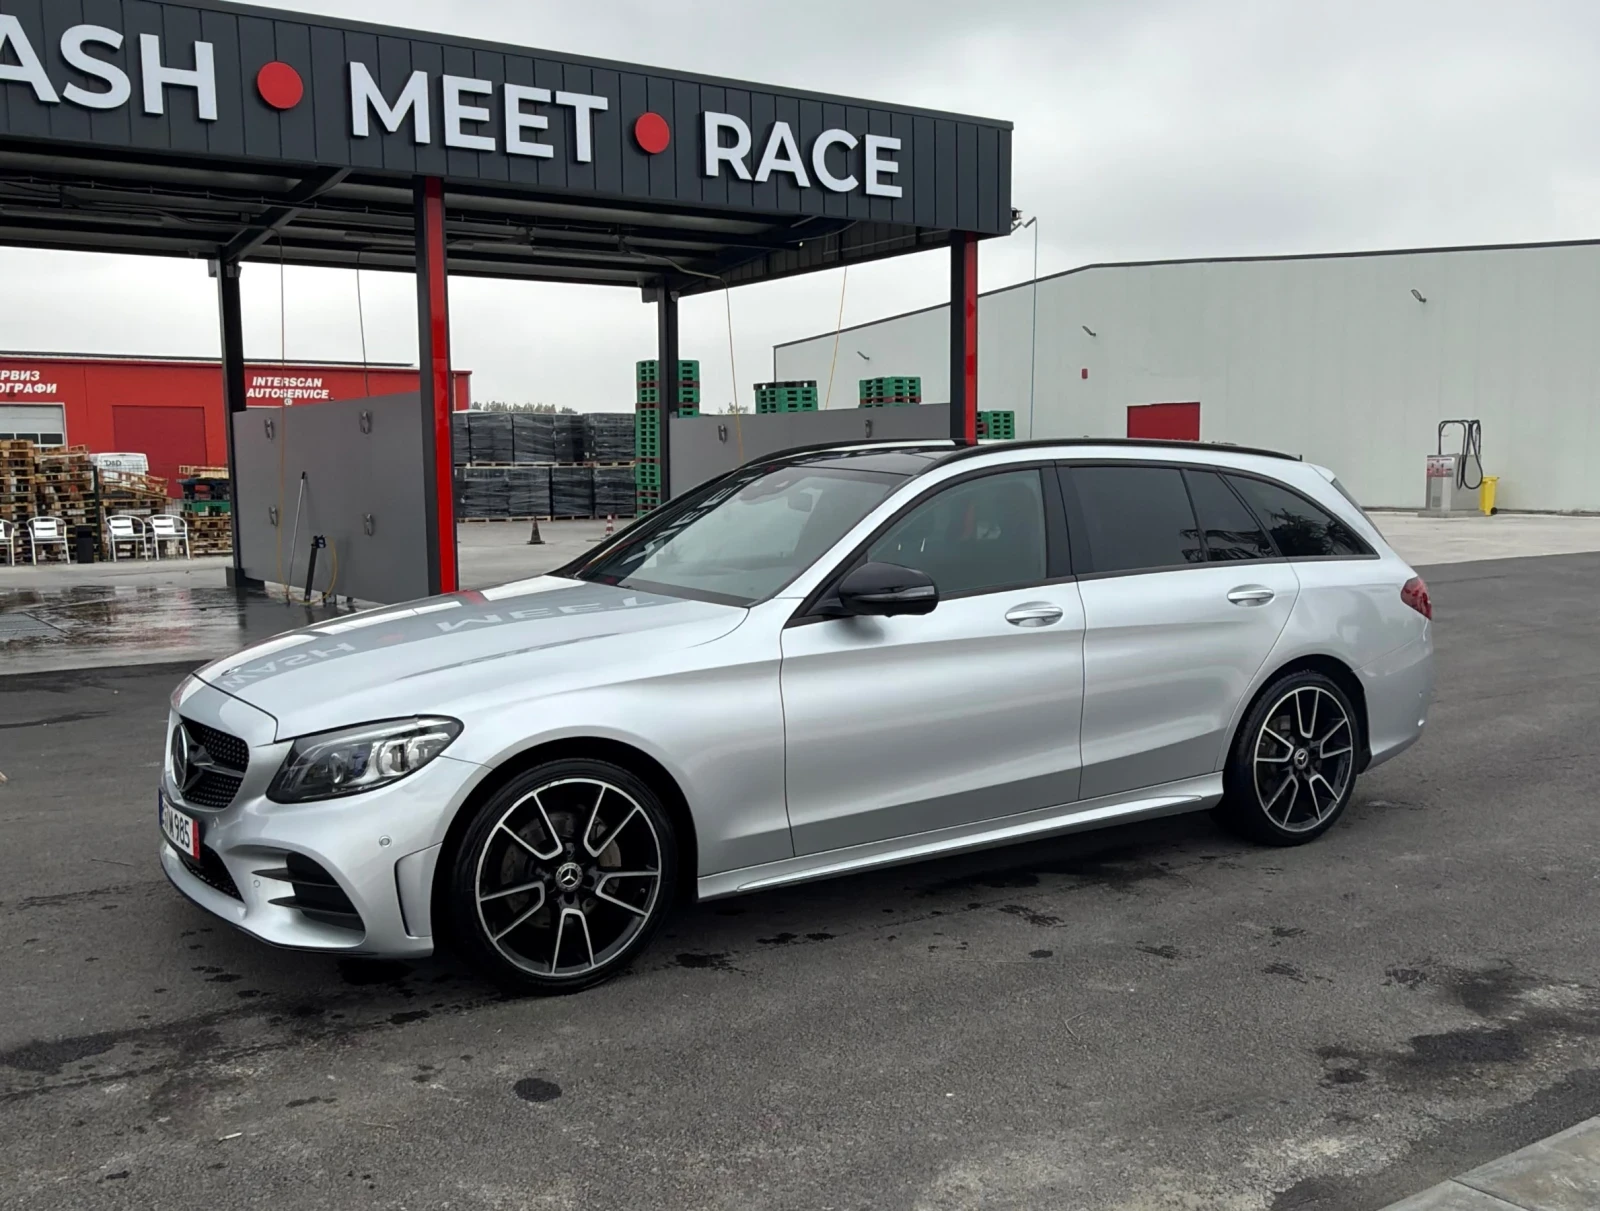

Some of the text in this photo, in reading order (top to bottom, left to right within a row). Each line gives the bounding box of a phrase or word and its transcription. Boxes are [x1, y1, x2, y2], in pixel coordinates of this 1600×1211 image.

[349, 61, 609, 163] MEET
[703, 111, 903, 198] RACE
[0, 369, 41, 381] РВИЗ
[252, 376, 323, 388] INTERSCAN
[246, 388, 330, 400] AUTOSERVICE
